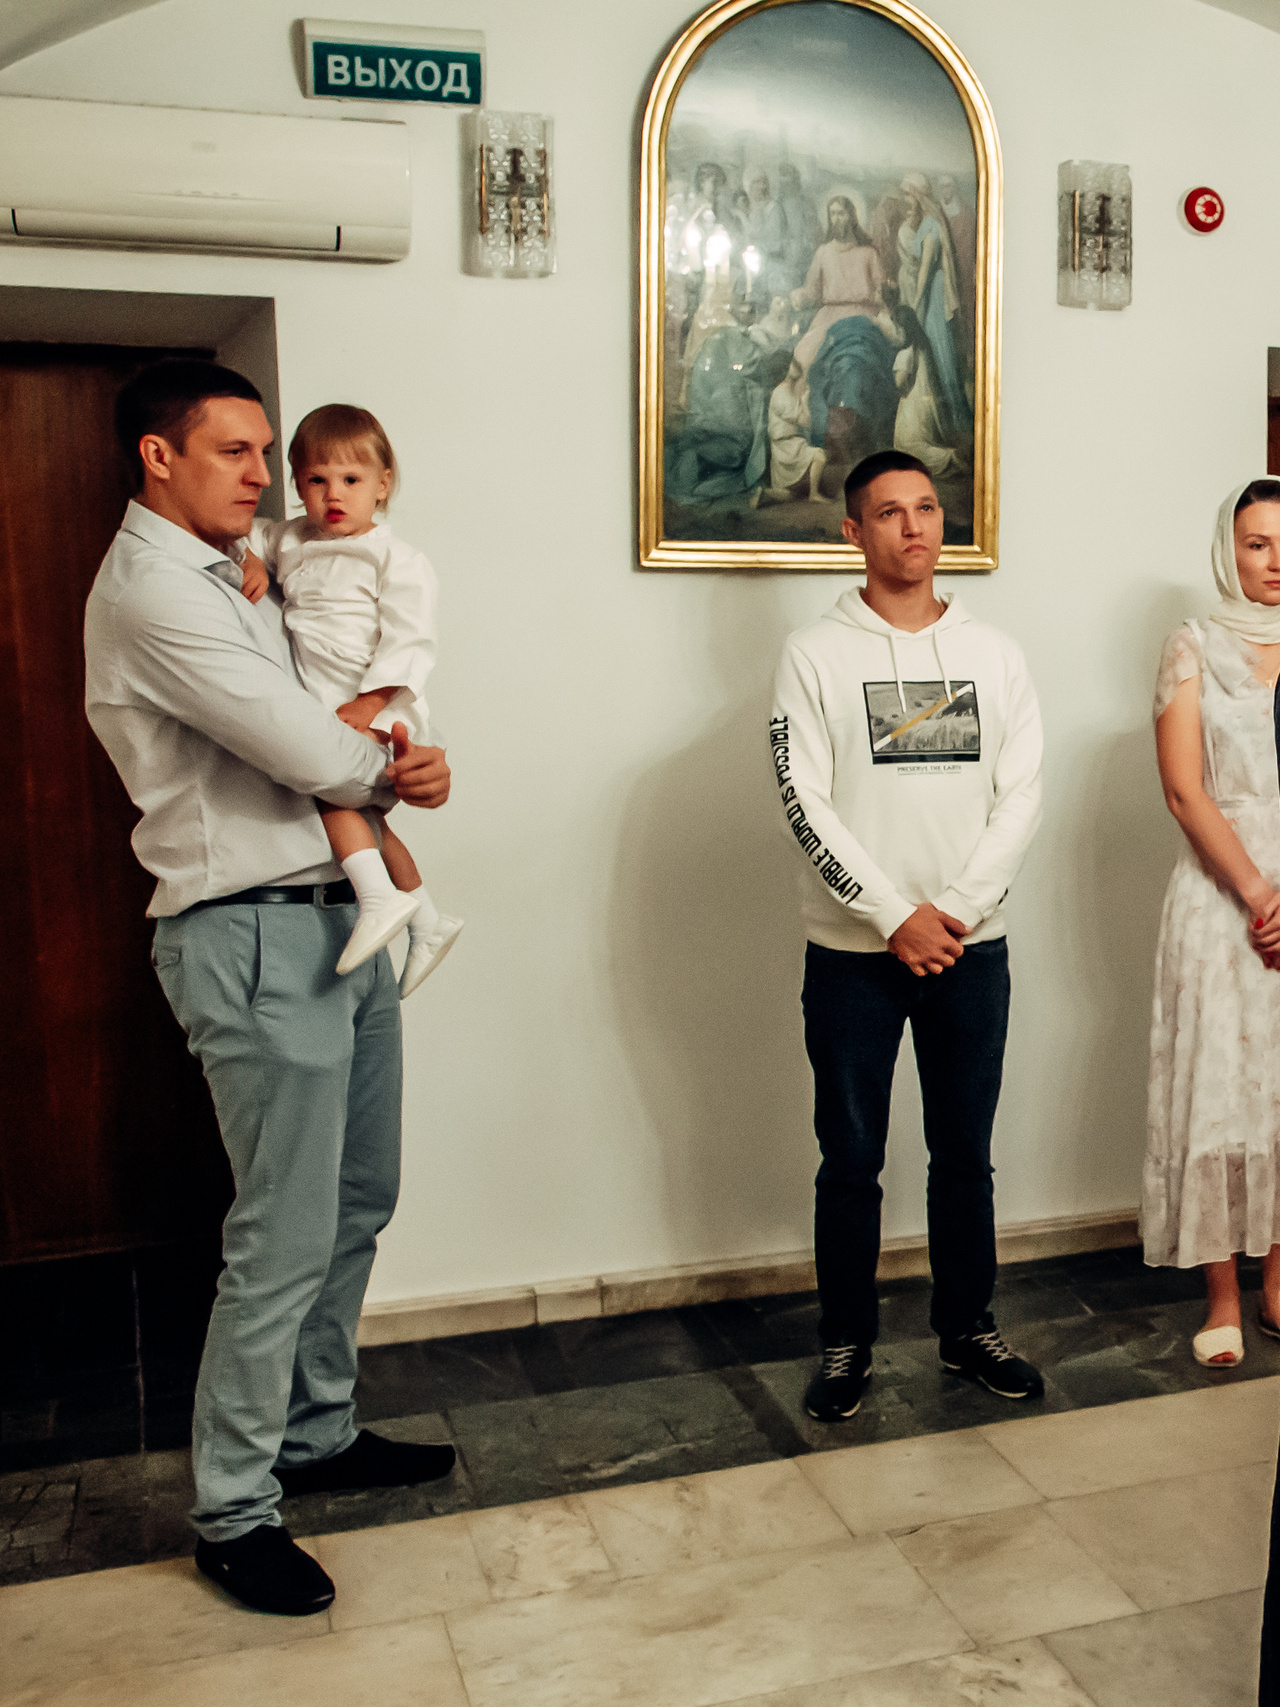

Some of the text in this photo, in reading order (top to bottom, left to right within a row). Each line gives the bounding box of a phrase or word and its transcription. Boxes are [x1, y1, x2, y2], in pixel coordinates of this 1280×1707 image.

[327, 54, 471, 99] ВЫХОД
[769, 715, 864, 905] LIVABLE WORLD IS POSSIBLE
